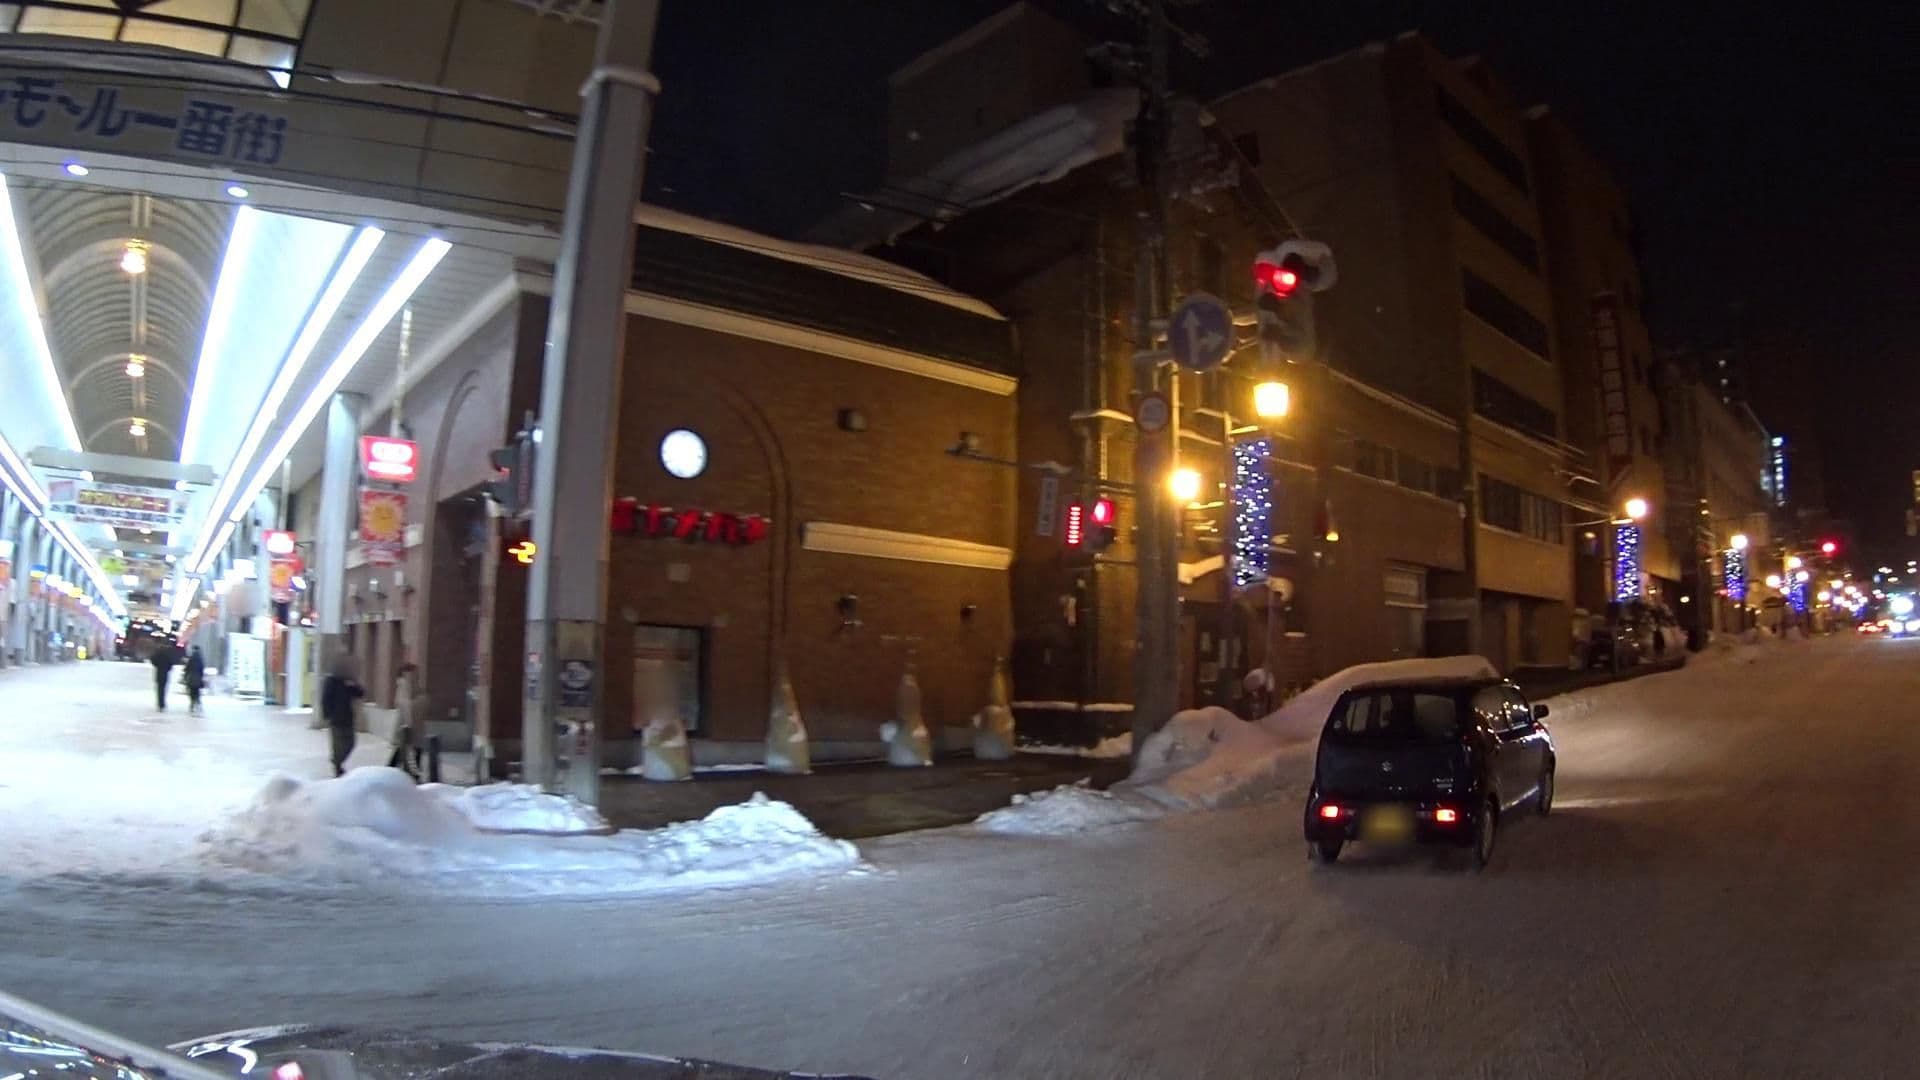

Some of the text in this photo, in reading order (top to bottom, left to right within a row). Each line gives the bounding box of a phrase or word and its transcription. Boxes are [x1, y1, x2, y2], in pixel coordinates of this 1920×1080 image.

[0, 77, 287, 163] モール一番街
